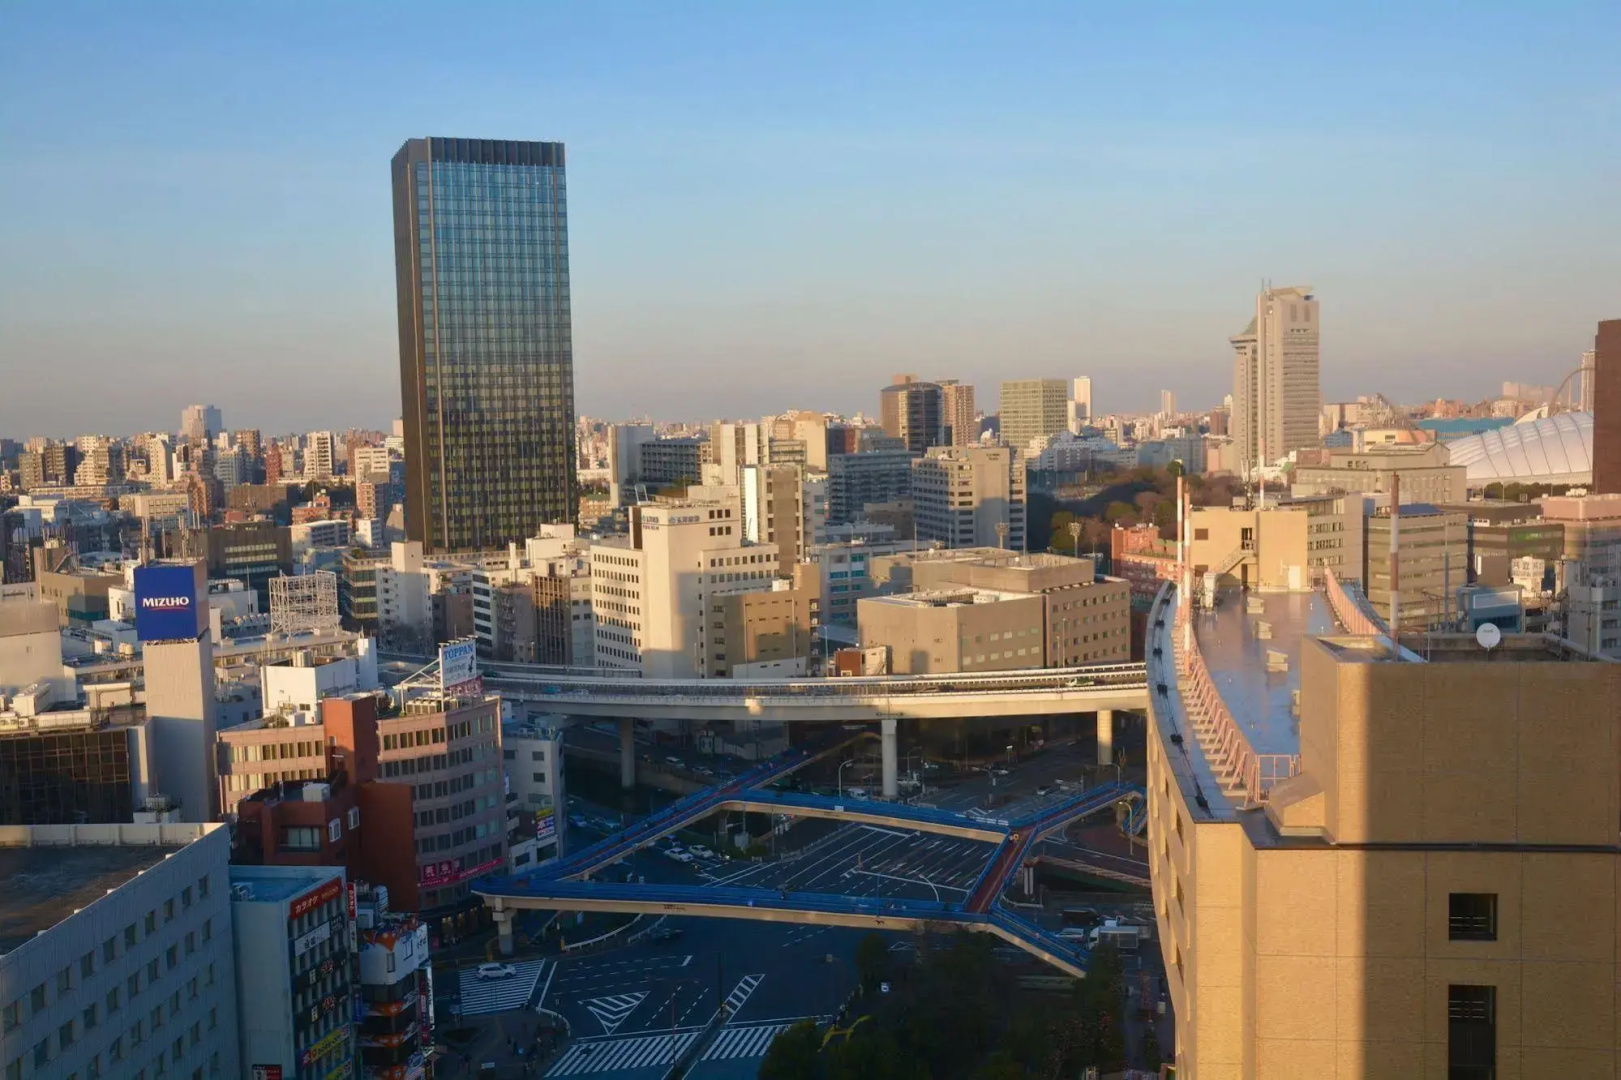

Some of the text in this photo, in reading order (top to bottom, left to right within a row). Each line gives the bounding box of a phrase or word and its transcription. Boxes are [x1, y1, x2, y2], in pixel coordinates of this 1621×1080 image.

[142, 597, 189, 608] MIZUHO
[443, 644, 474, 660] TOPPAN
[295, 895, 319, 914] カラオケ
